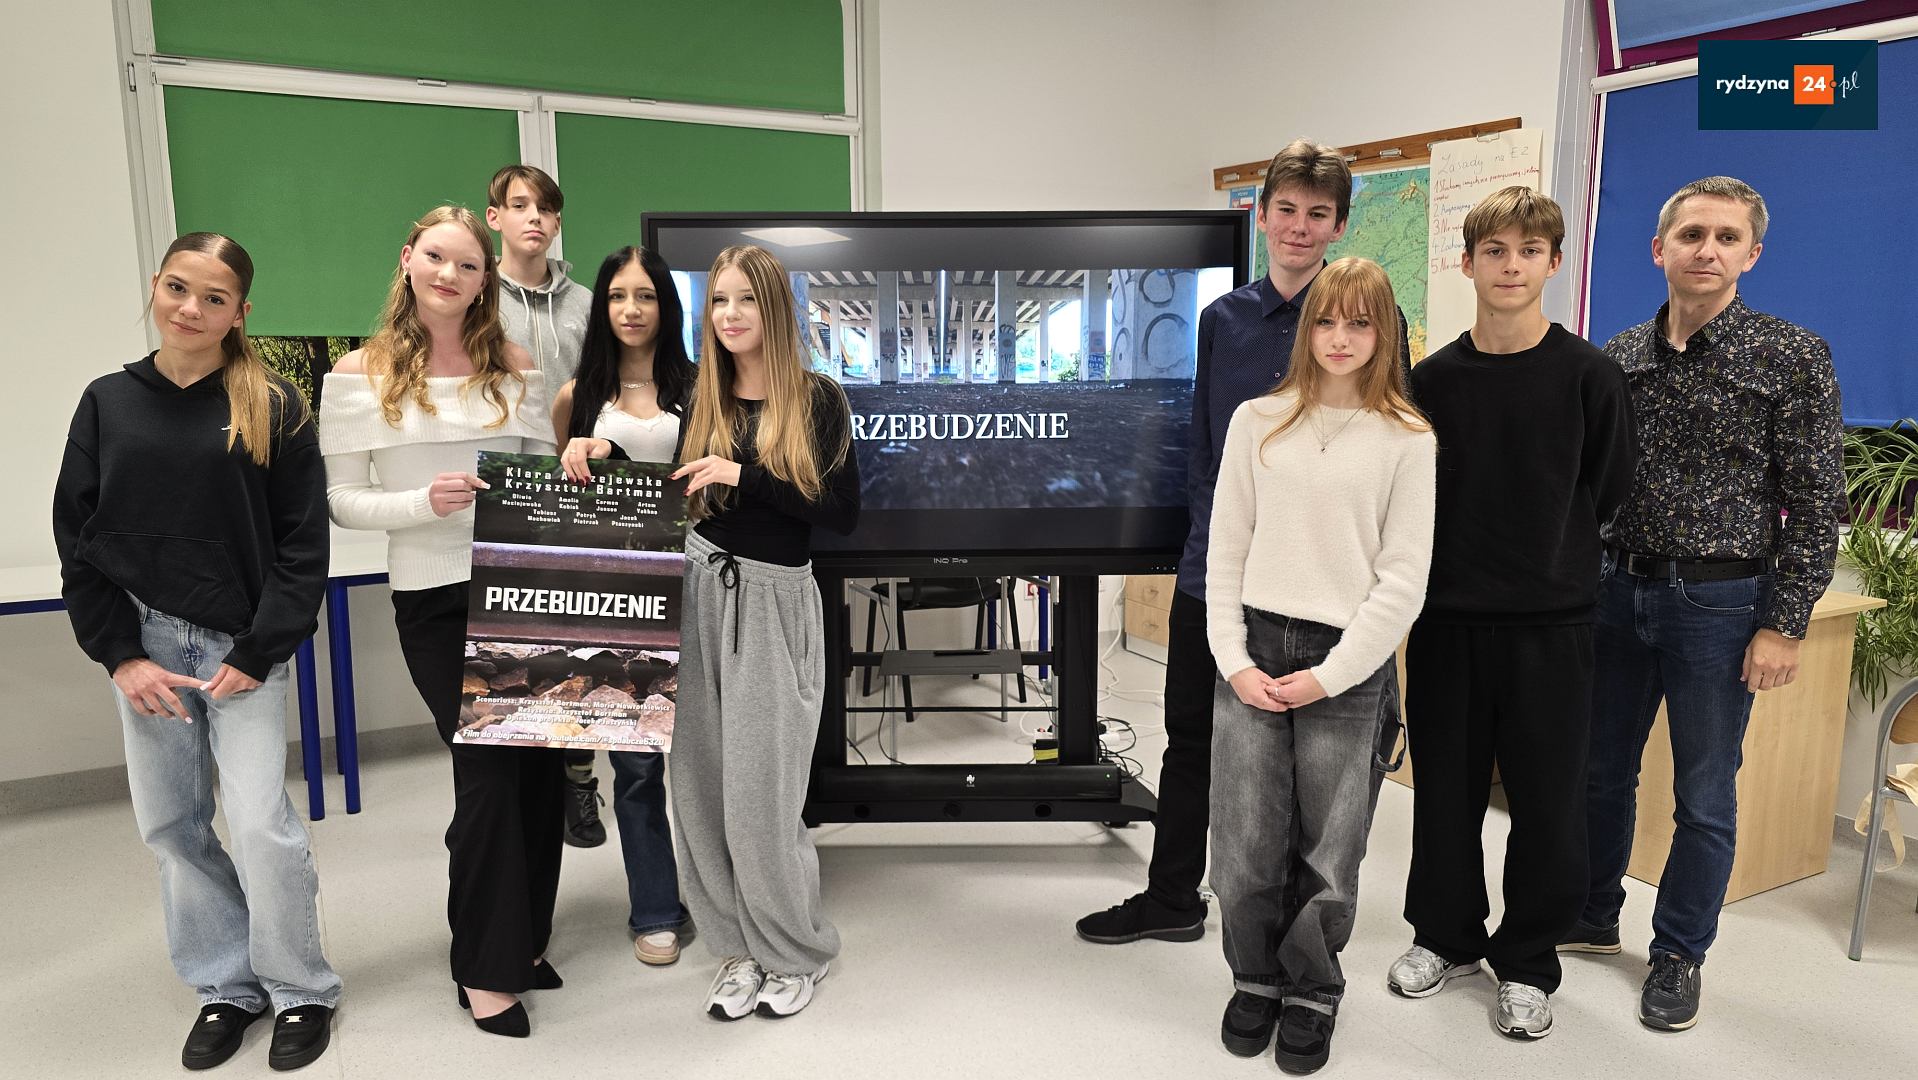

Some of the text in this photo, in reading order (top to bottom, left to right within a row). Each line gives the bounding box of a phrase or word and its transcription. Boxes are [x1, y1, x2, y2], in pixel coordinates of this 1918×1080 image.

[851, 413, 1069, 440] RZEBUDZENIE
[506, 466, 662, 487] Klara Azejewska
[596, 484, 662, 499] Bartman
[576, 511, 597, 519] Patryk
[485, 586, 667, 619] PRZEBUDZENIE
[519, 697, 554, 706] Krzysztof
[559, 708, 593, 717] Krzysztof
[594, 710, 627, 718] Bartman
[463, 728, 480, 738] Film
[481, 730, 492, 738] do
